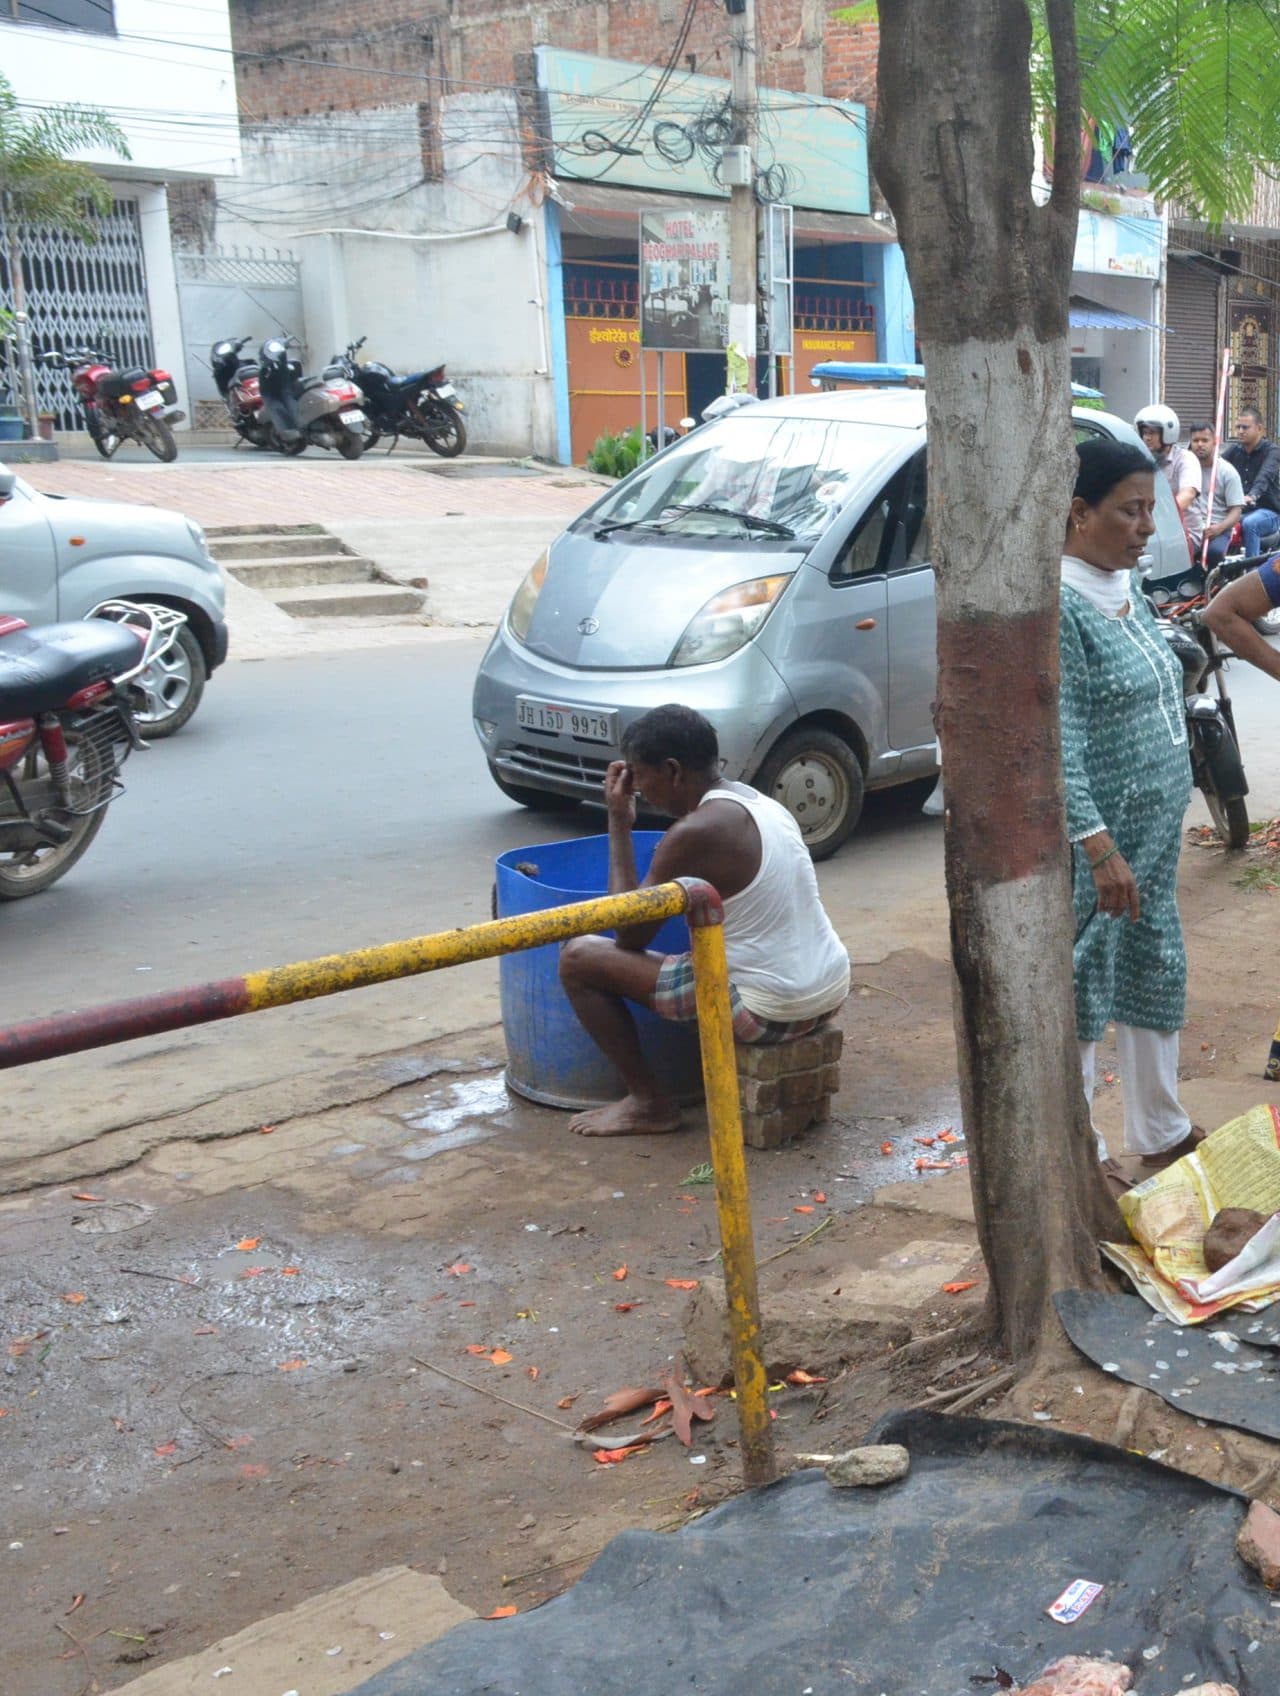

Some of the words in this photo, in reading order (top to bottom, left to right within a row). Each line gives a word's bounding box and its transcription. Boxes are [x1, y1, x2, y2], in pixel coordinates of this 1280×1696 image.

[665, 220, 695, 238] HOTEL
[518, 702, 534, 724] JH
[571, 714, 608, 738] 9979
